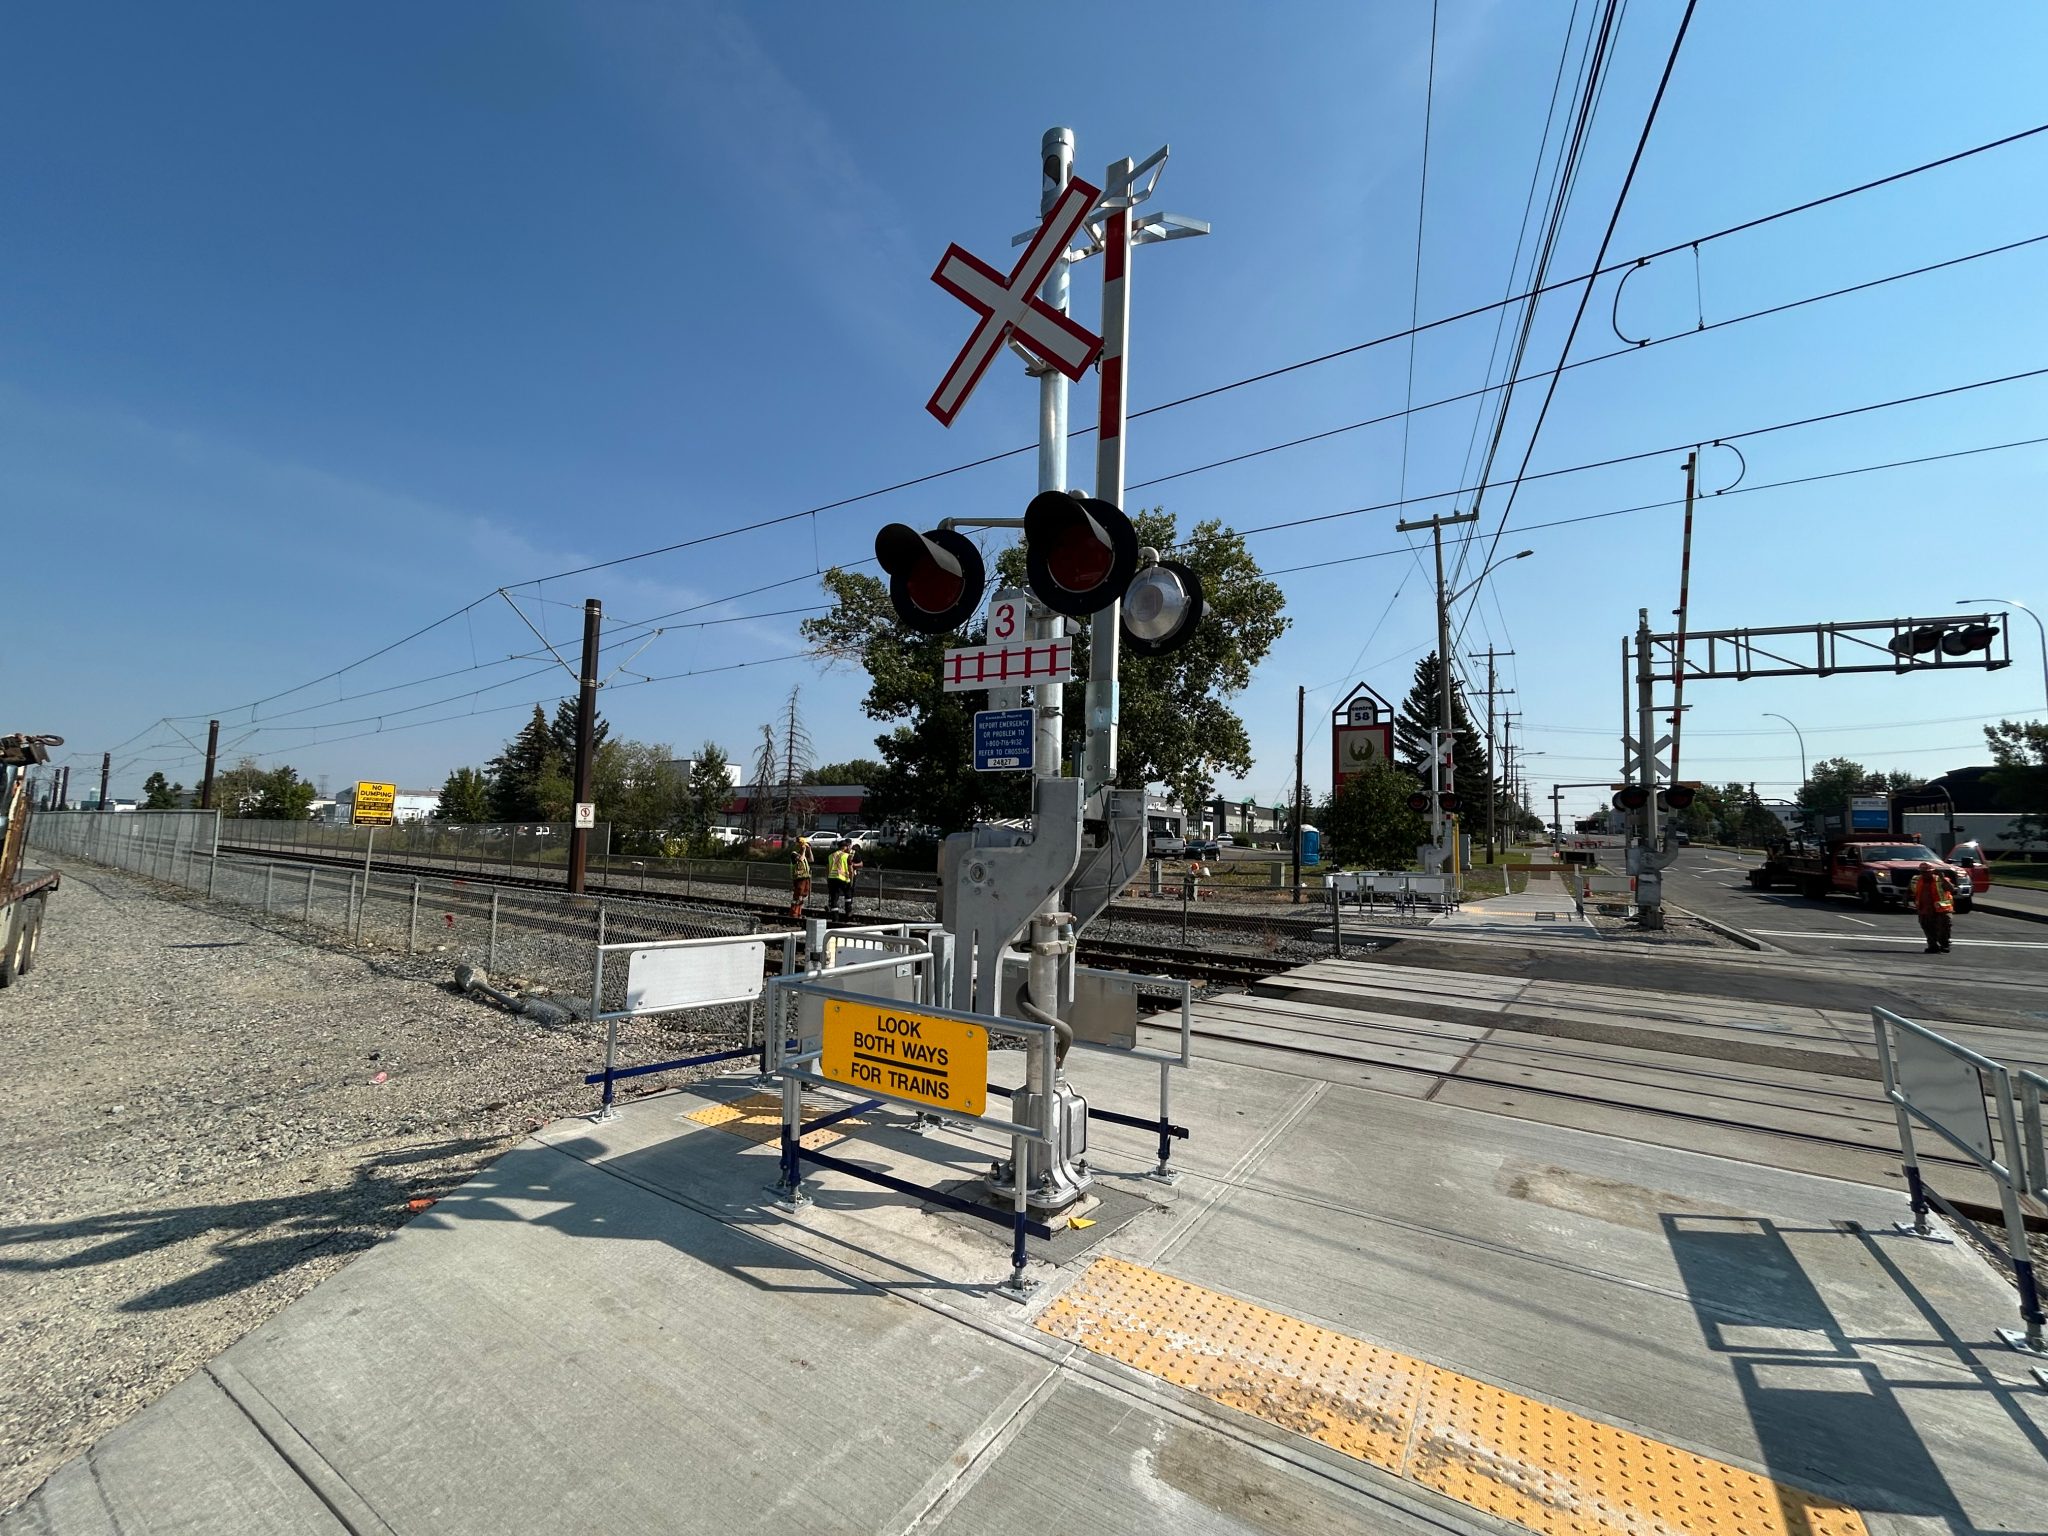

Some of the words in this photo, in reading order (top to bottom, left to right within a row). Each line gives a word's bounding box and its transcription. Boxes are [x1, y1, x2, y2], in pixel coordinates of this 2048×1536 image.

[995, 604, 1015, 638] 3
[999, 720, 1030, 728] EMERGENCY
[1354, 712, 1370, 721] 58
[993, 730, 1016, 738] PROBLEM
[1004, 747, 1030, 755] CROSSING
[878, 1015, 921, 1038] LOOK
[854, 1031, 895, 1055] BOTH
[902, 1041, 949, 1066] WAYS
[851, 1062, 881, 1084] FOR
[888, 1071, 950, 1100] TRAINS
